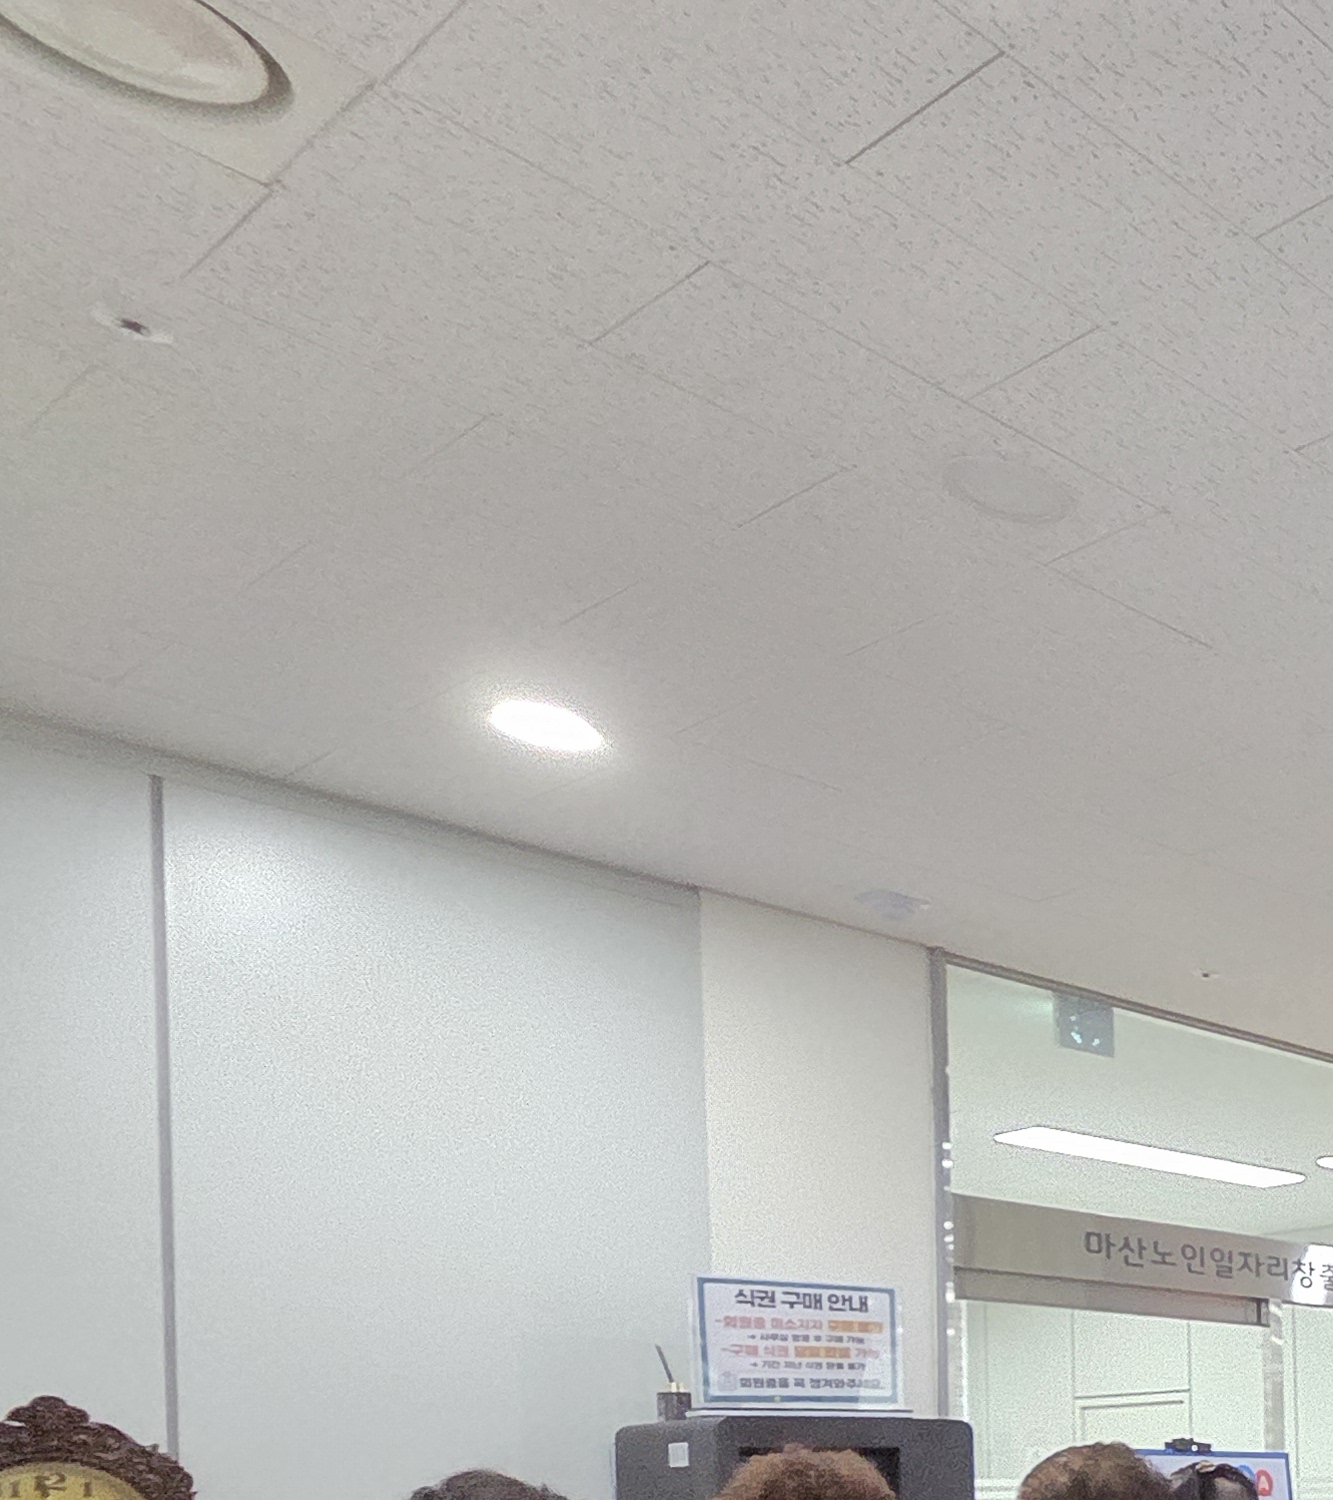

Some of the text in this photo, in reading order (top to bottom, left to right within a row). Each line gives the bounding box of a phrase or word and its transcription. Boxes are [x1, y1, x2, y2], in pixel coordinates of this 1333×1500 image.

[735, 1289, 868, 1313] 식권 구매 안내
[83, 1482, 93, 1497] 1
